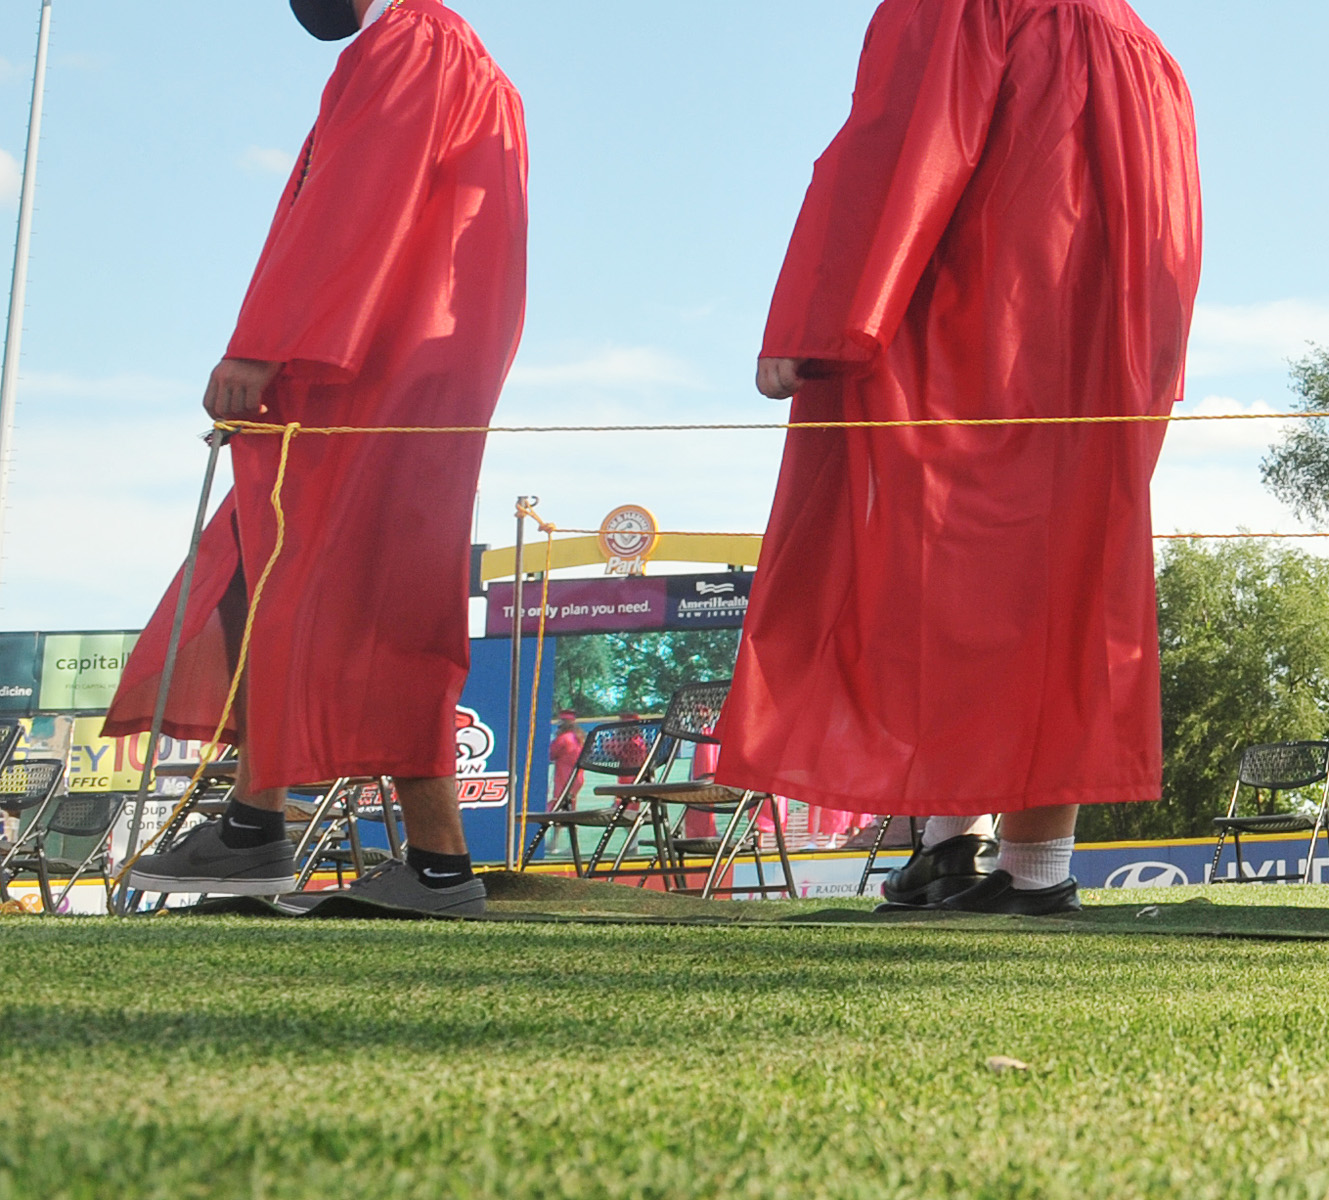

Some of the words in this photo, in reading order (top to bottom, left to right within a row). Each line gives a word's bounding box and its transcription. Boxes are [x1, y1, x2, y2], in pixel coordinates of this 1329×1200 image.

[604, 556, 646, 575] Park
[561, 603, 589, 618] plan
[591, 604, 615, 617] you
[617, 600, 652, 614] need.
[56, 653, 130, 675] capital
[456, 779, 509, 801] DS
[124, 804, 167, 818] Goup
